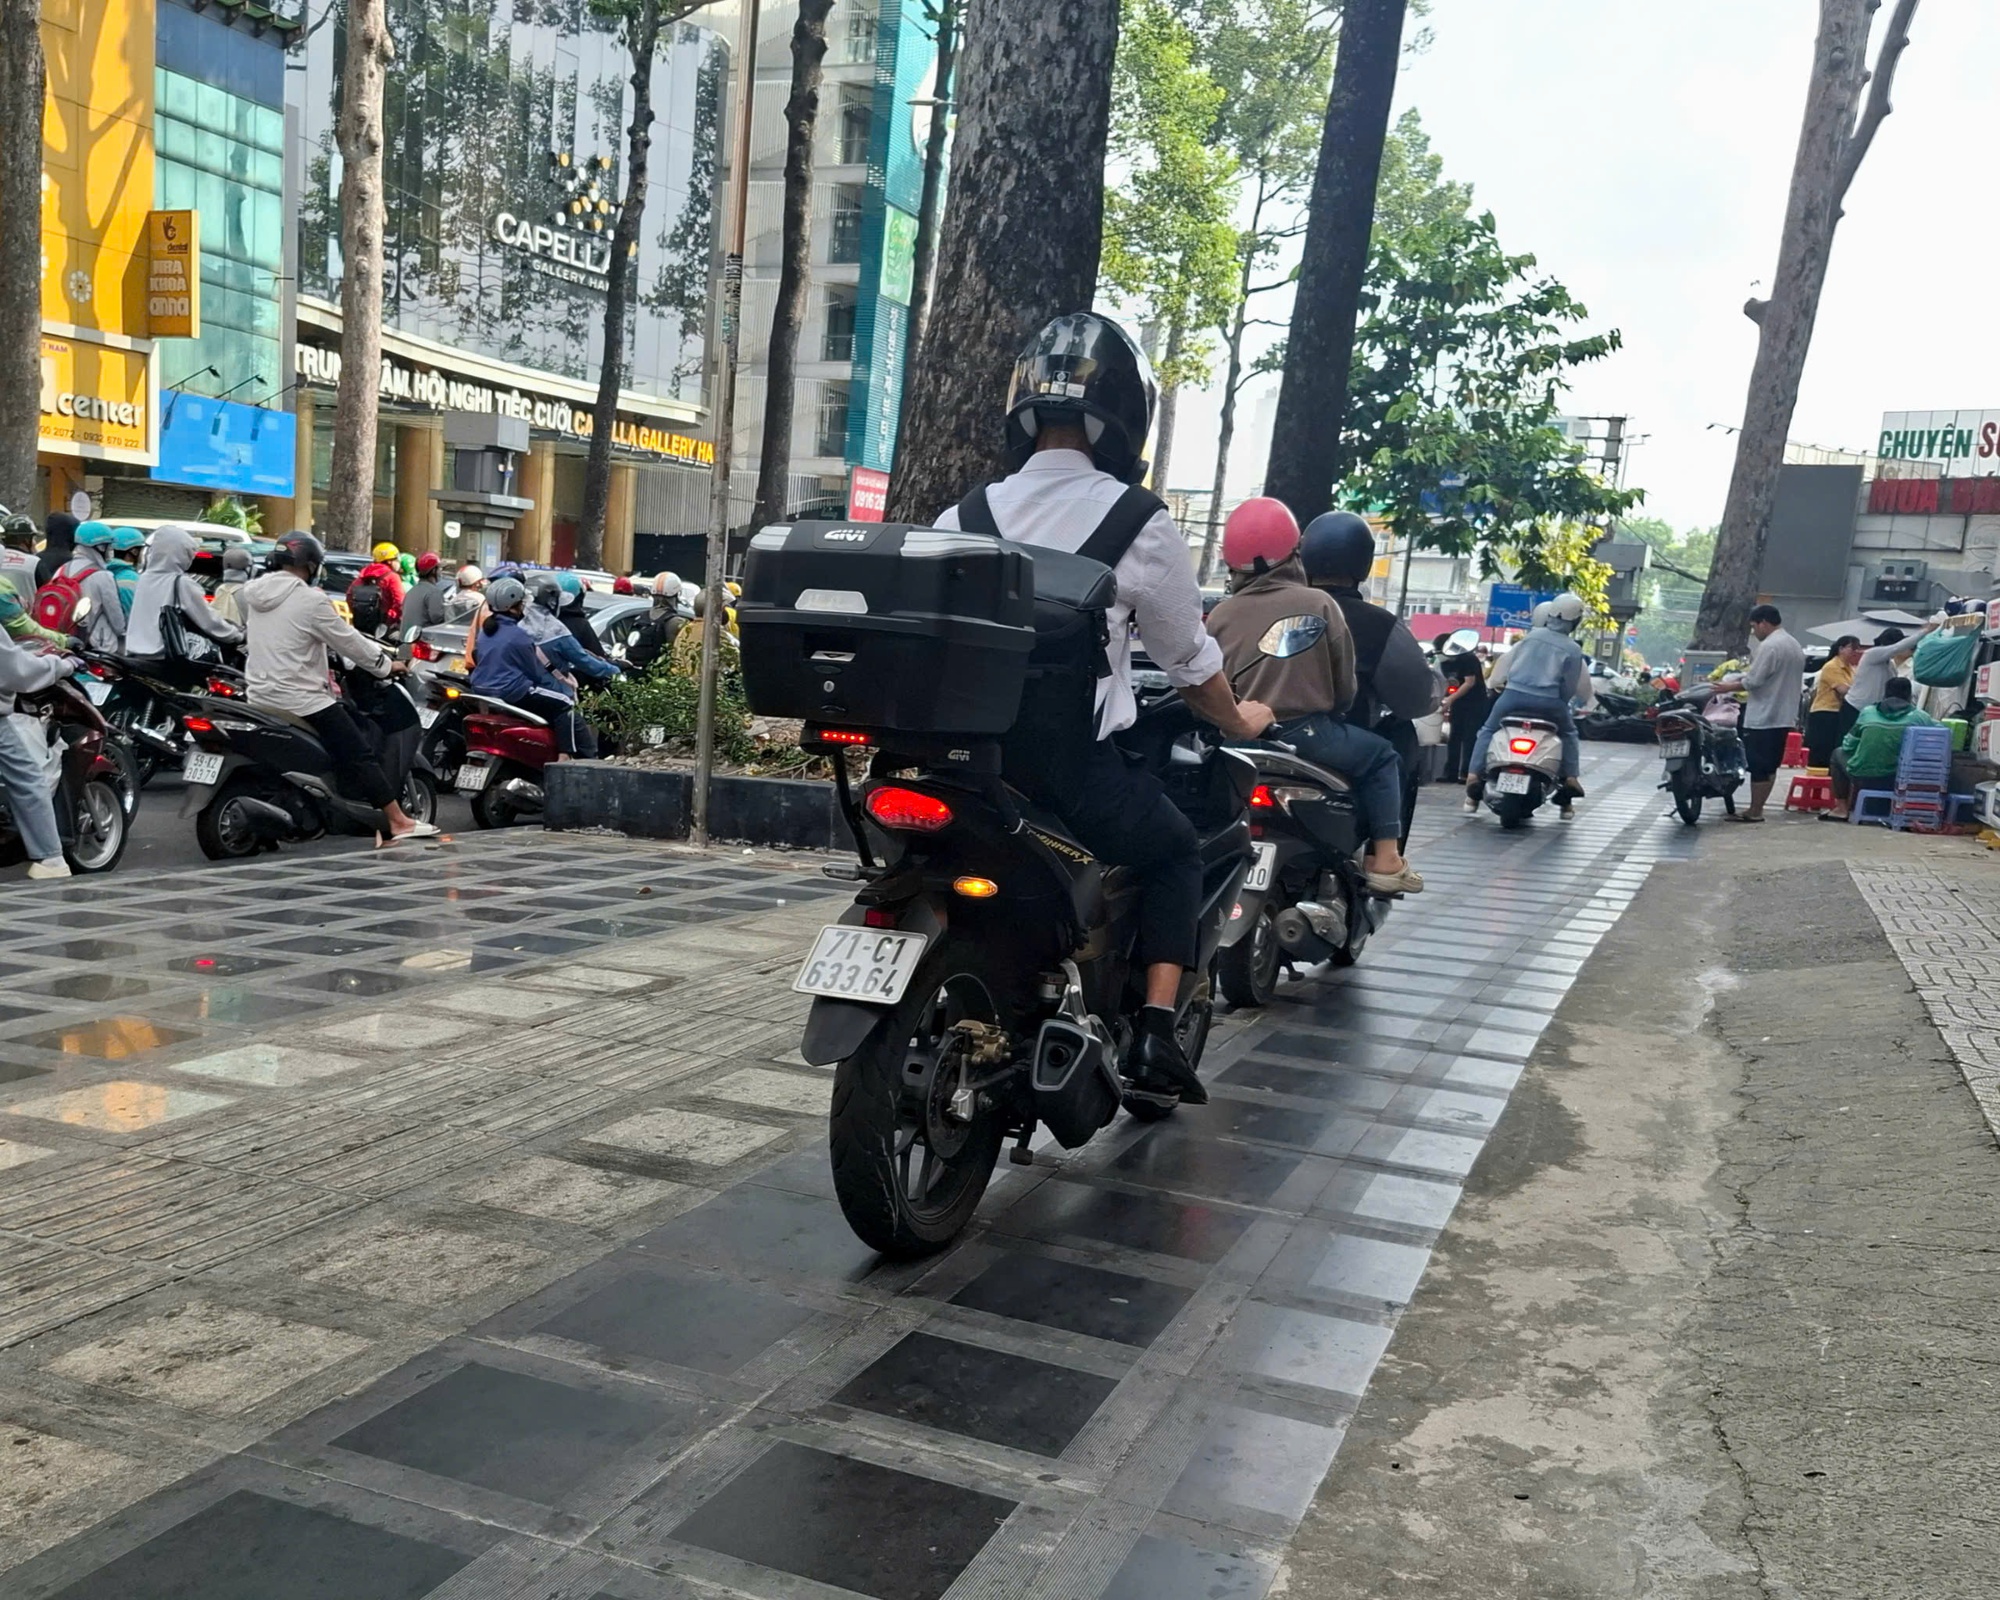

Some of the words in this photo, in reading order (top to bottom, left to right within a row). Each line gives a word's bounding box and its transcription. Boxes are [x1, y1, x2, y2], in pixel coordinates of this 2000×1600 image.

[149, 277, 188, 292] KHOA
[532, 259, 587, 284] GALLERY
[57, 391, 144, 428] center
[295, 343, 342, 382] TRUN
[379, 358, 409, 397] ÂM
[639, 426, 697, 460] GALLERY
[1878, 422, 1973, 459] CHUYÊN
[1979, 421, 2000, 458] S
[1867, 478, 1939, 515] MUA
[825, 931, 908, 965] 71-C1
[804, 960, 898, 997] 633.64
